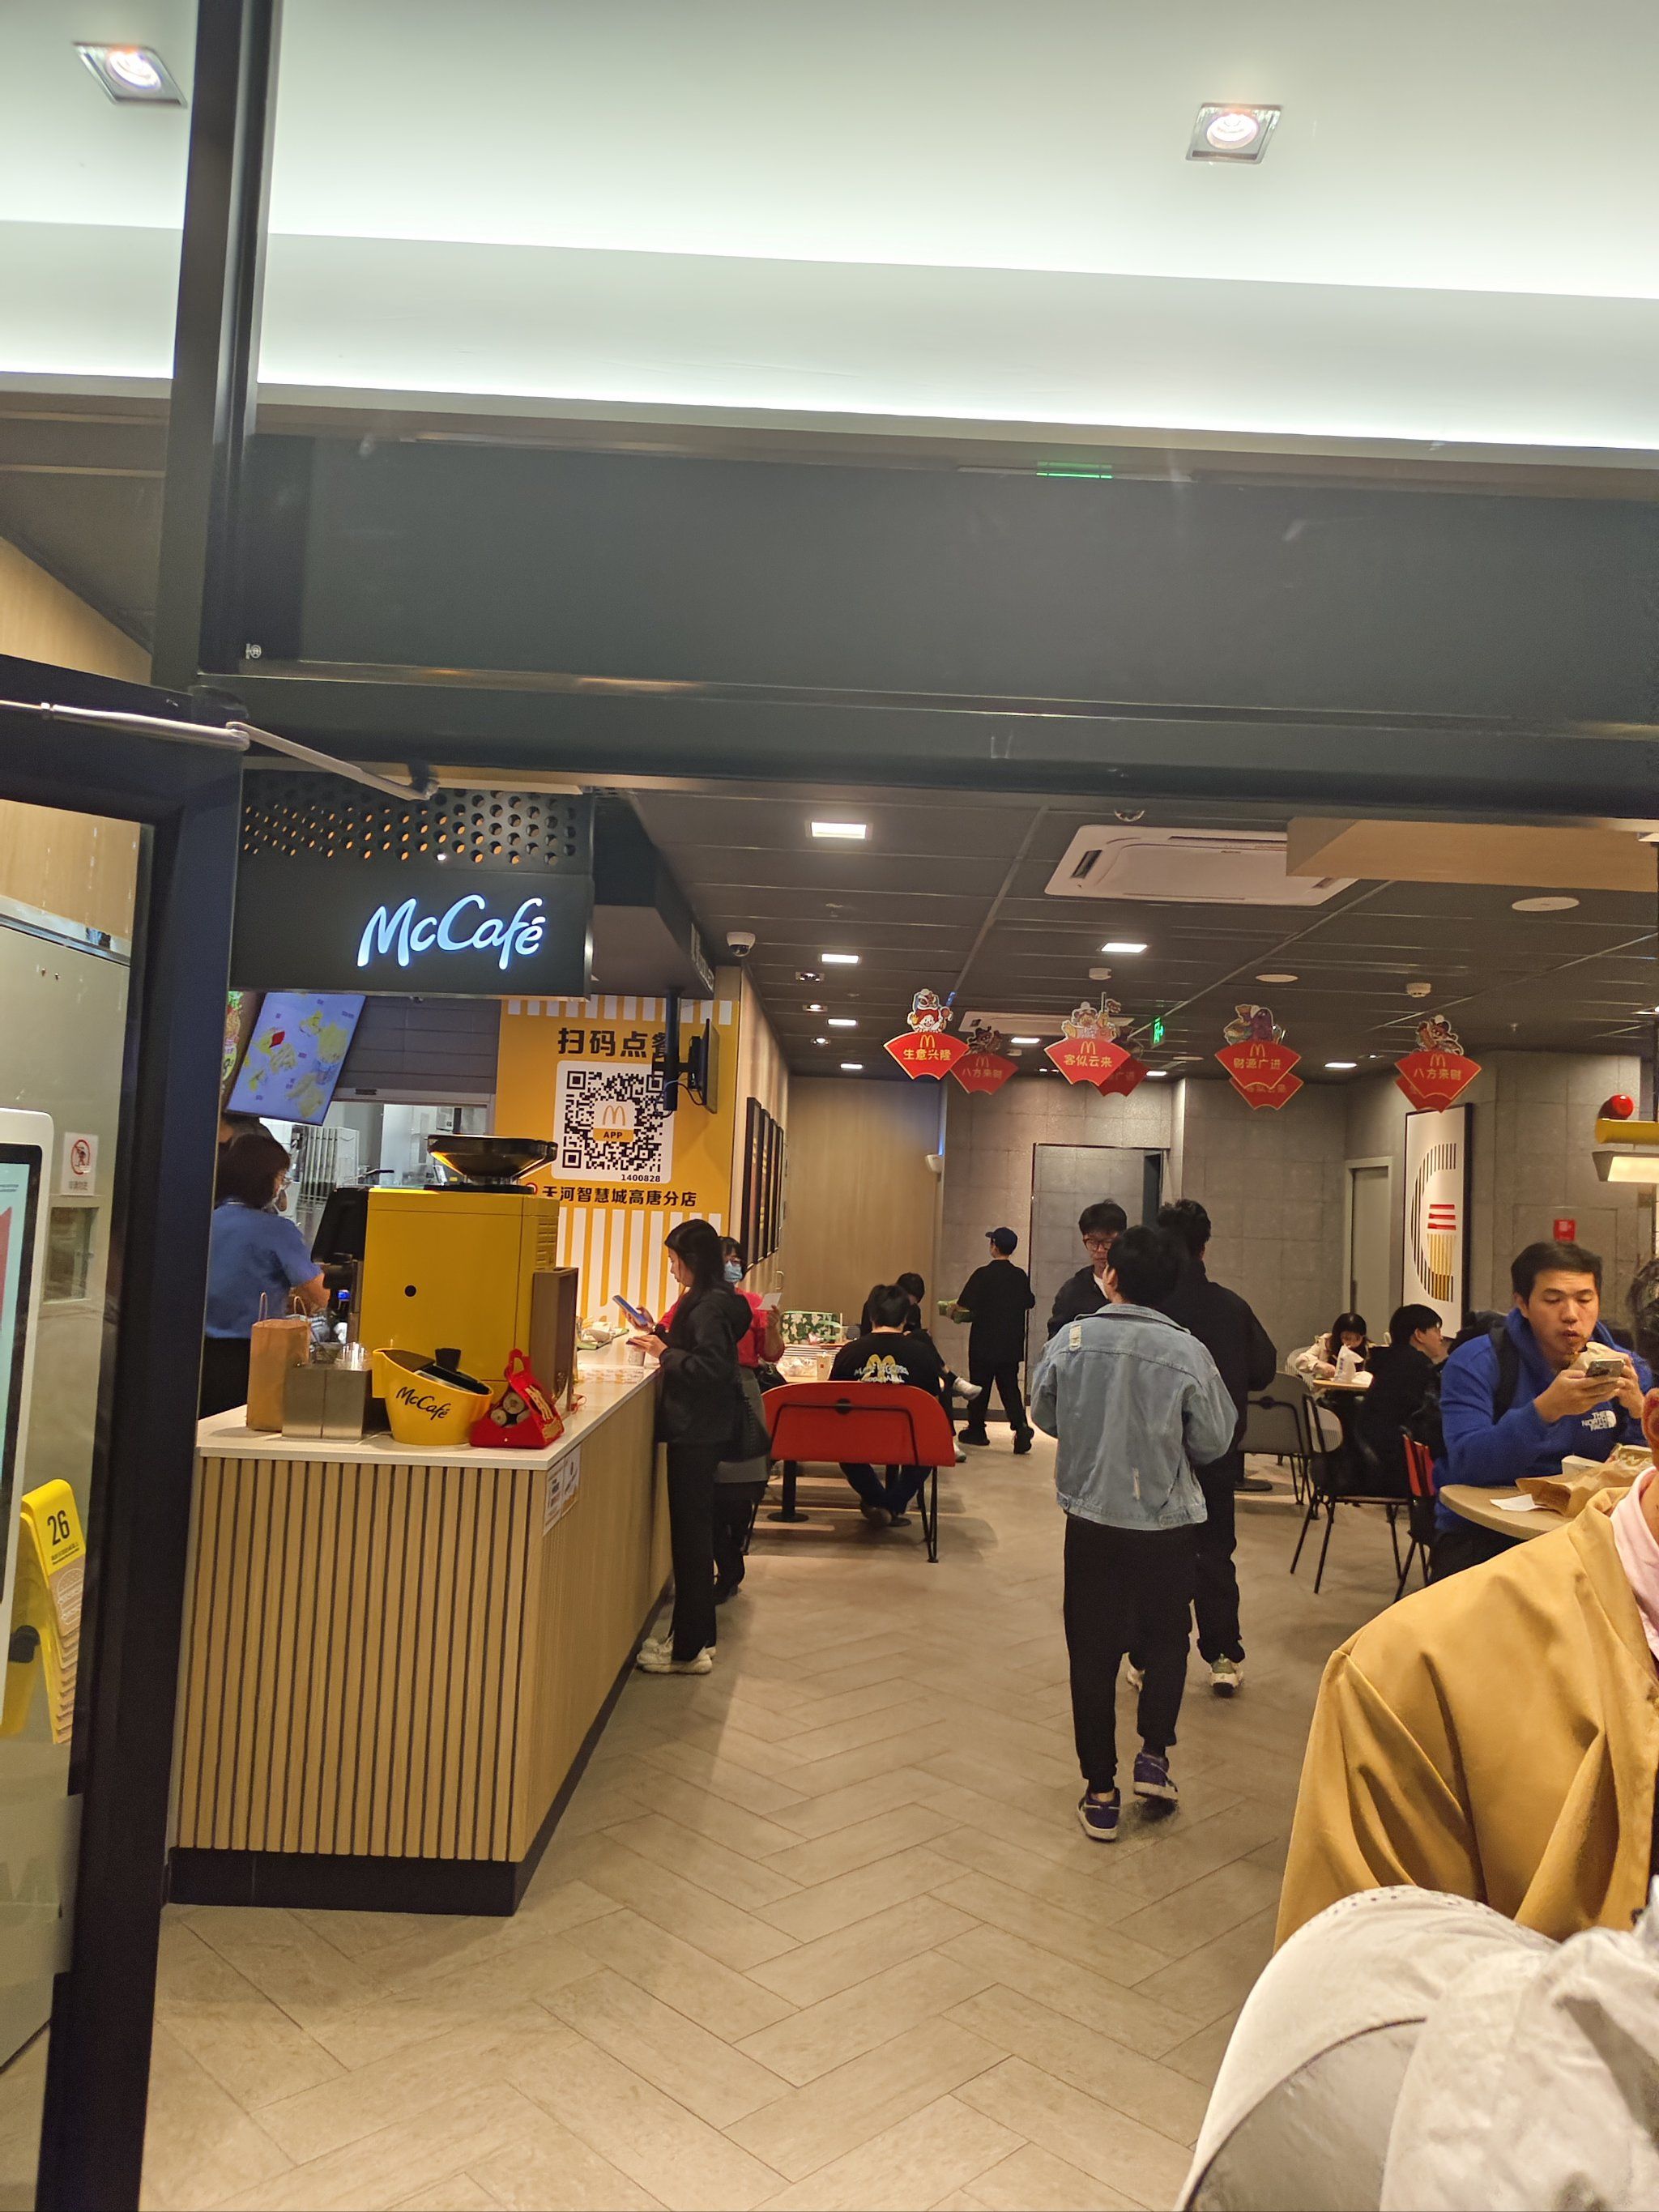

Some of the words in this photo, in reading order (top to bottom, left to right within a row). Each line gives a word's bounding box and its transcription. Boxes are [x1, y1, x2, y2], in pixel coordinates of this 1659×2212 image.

[356, 894, 546, 970] McCafé
[903, 1049, 951, 1060] 生意兴隆
[1064, 1054, 1112, 1068] 客似云来
[621, 1174, 661, 1183] 1400828
[542, 1186, 697, 1207] 天河智慧城高唐分店
[395, 1387, 452, 1421] McCafé
[47, 1510, 70, 1545] 26
